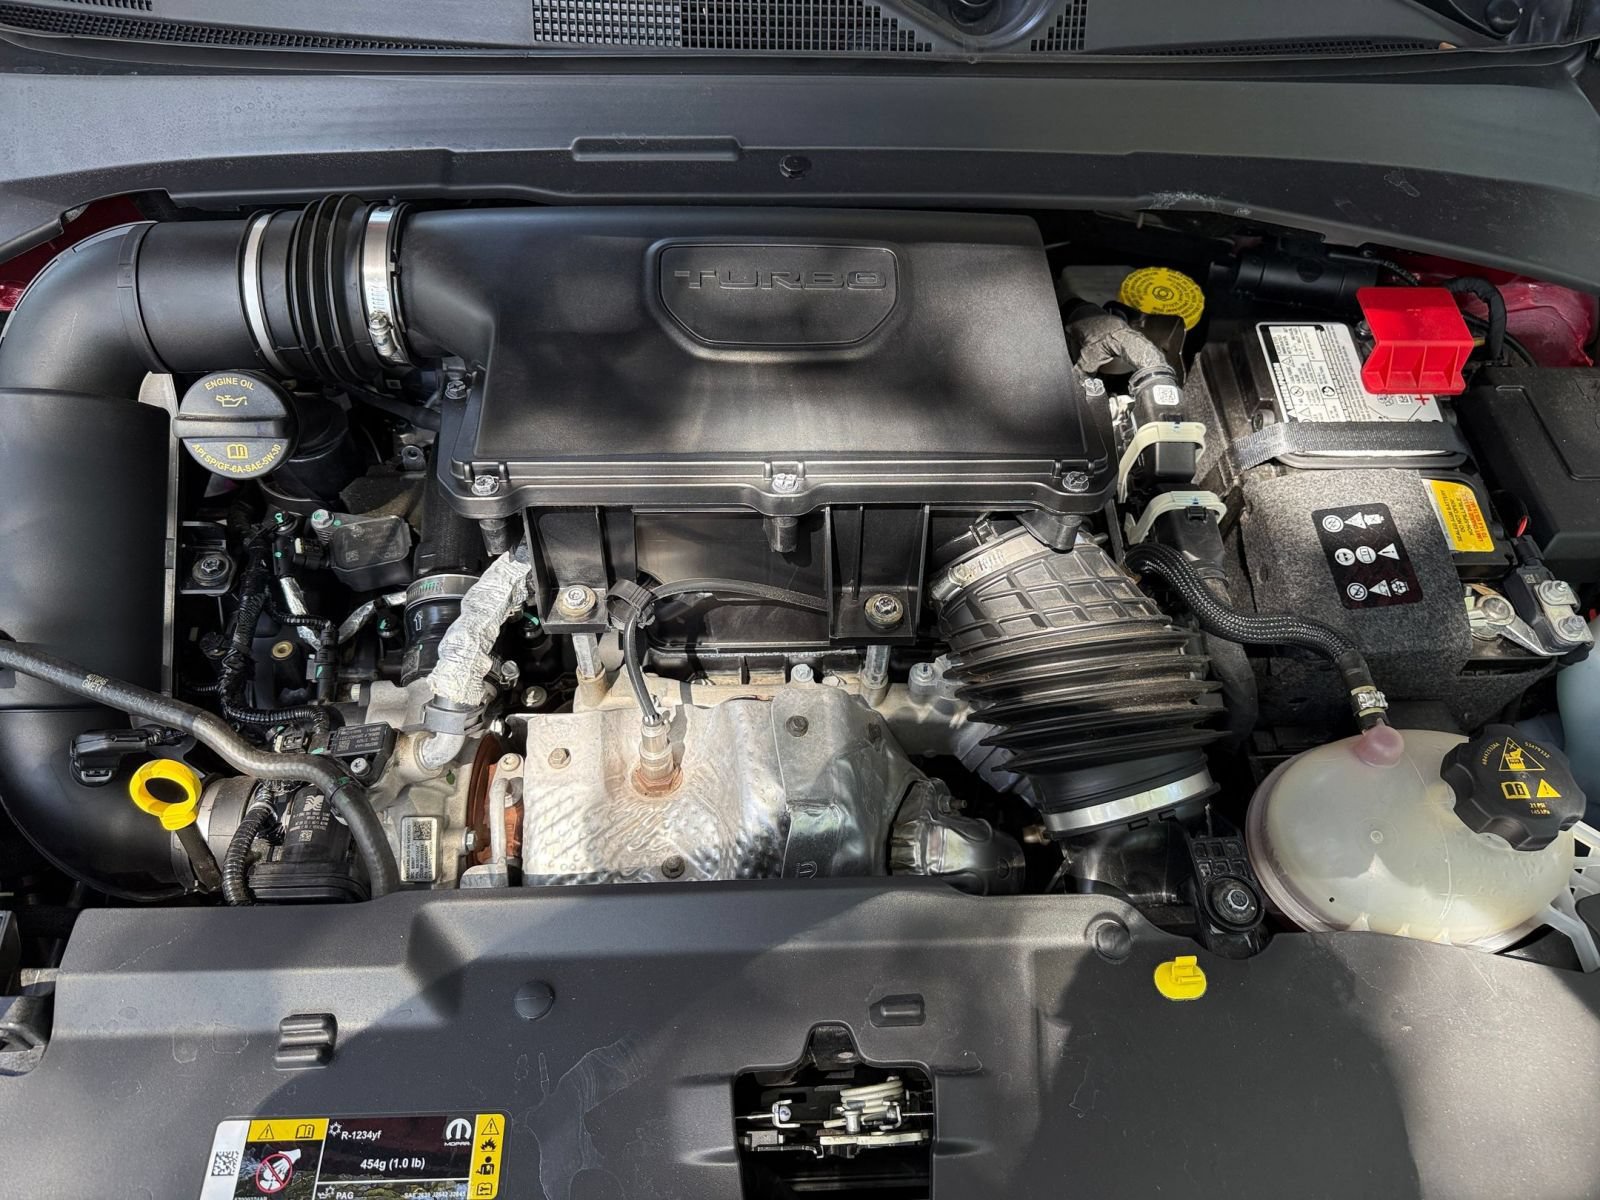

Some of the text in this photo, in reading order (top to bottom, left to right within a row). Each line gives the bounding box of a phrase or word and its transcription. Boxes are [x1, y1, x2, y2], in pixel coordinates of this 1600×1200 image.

[673, 270, 887, 290] TURBO
[204, 377, 255, 391] ENGINE OIL
[192, 443, 206, 458] API
[1455, 514, 1463, 525] NOT
[341, 1130, 382, 1141] R-1234yf
[360, 1157, 426, 1171] 454g (1.0 lb)
[335, 1191, 354, 1200] PAG
